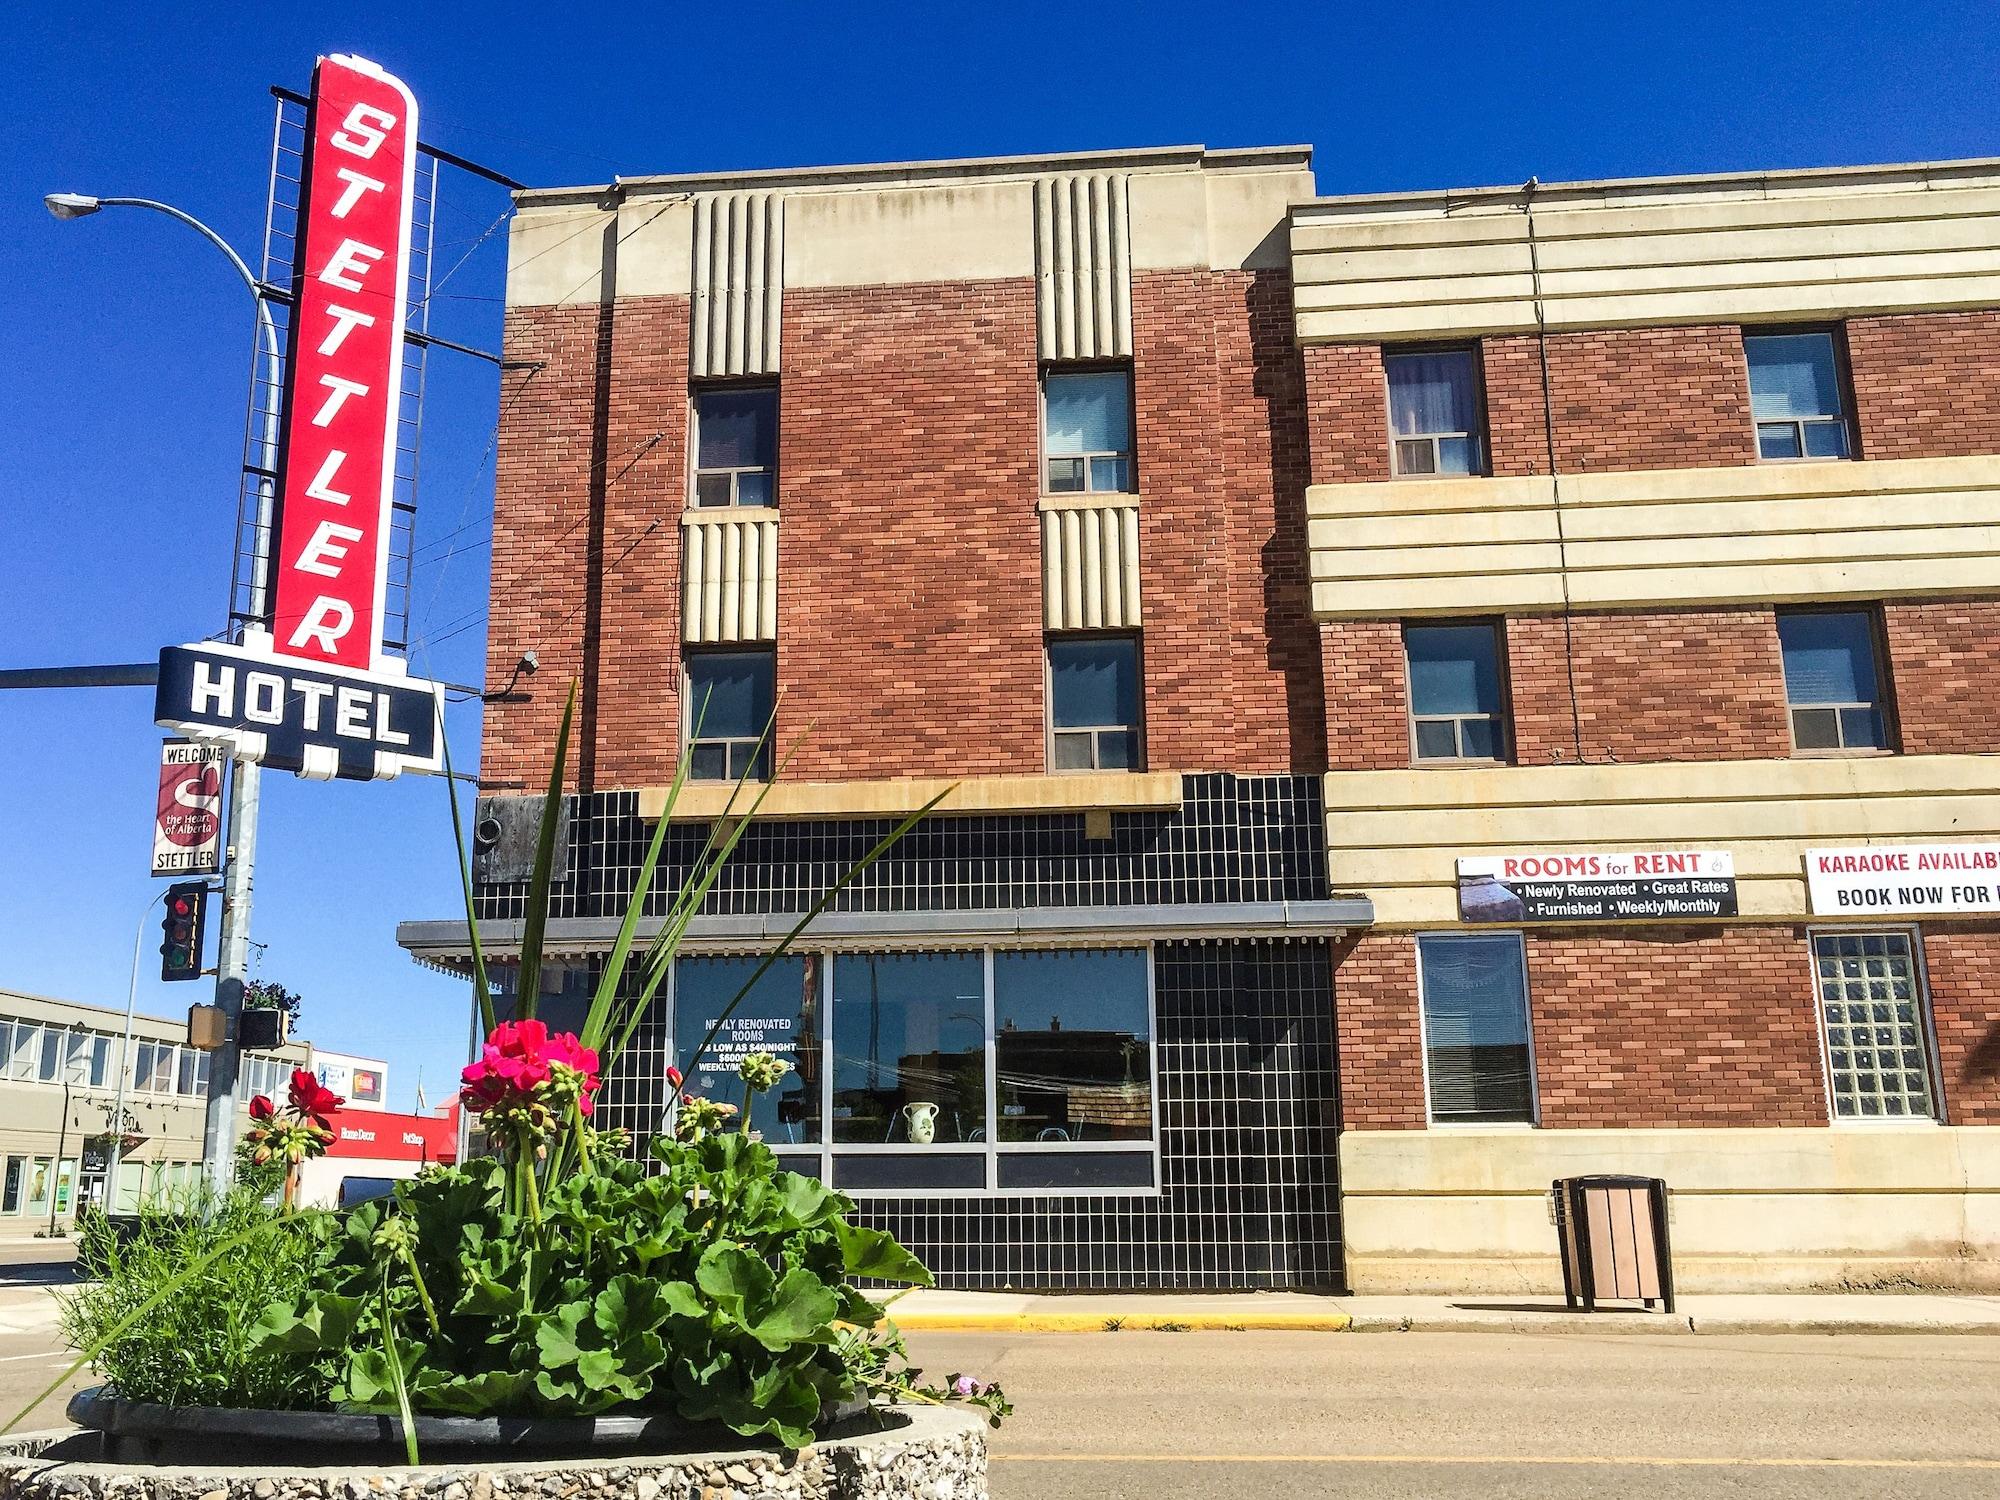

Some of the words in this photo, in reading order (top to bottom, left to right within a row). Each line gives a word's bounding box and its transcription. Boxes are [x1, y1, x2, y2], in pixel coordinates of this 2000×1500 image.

[287, 102, 397, 655] STETTLER
[190, 661, 409, 745] HOTEL
[168, 747, 224, 763] WELCOME
[166, 814, 183, 825] the
[185, 813, 211, 824] Heart
[165, 825, 177, 836] of
[177, 823, 212, 835] Alberta
[157, 850, 214, 869] STETTLER
[1504, 856, 1600, 878] ROOMS
[1606, 862, 1629, 875] for
[1634, 853, 1701, 875] RENT
[1818, 853, 1910, 874] KARAOKE
[1918, 851, 2000, 871] AVAILAB
[1525, 884, 1564, 900] Newly
[1567, 882, 1637, 897] Renovated
[1651, 881, 1689, 895] Great
[1691, 880, 1730, 894] Rates
[1837, 888, 1893, 907] BOOK
[1898, 886, 1943, 905] NOW
[1951, 885, 1991, 904] FOR
[1536, 901, 1603, 916] Furnished
[1616, 898, 1722, 917] Weekly/Monthly
[738, 1019, 791, 1030] RENOVATED
[731, 1030, 764, 1042] ROOMS
[712, 1043, 734, 1053] LOW
[734, 1043, 748, 1052] AS
[749, 1043, 797, 1052] $40/NIGHT
